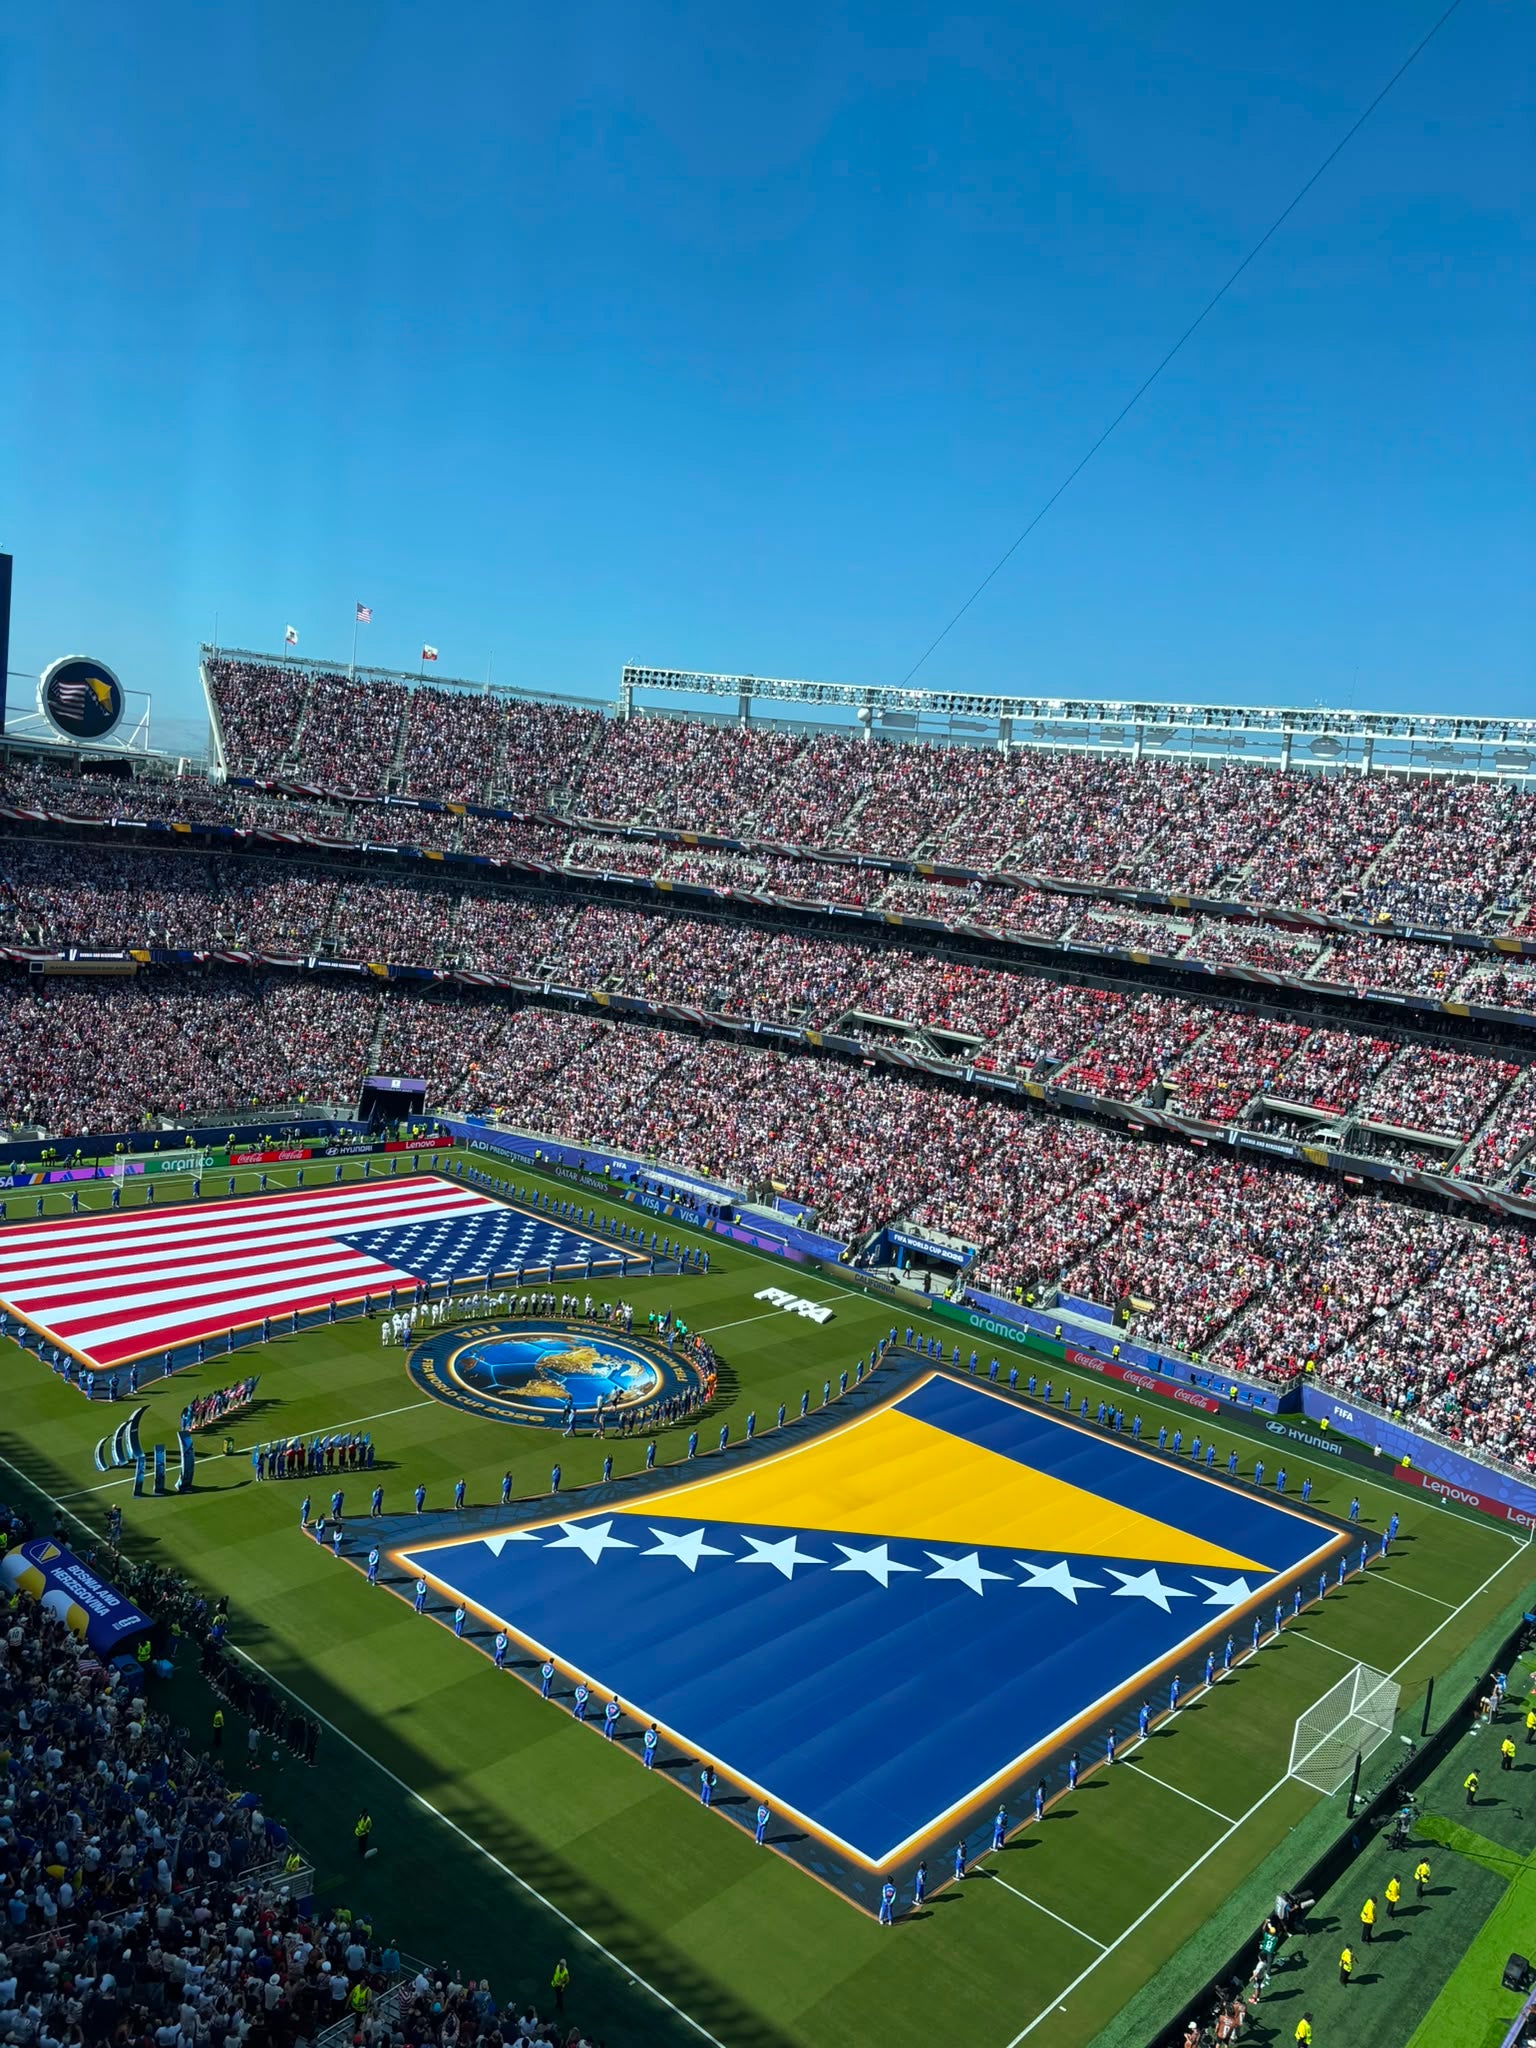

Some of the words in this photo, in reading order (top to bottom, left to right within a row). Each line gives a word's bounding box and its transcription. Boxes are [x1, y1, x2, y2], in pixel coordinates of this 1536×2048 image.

[340, 1145, 372, 1154] HYUNDAI
[405, 1139, 435, 1149] Lenovo
[470, 1139, 489, 1151] ADI
[161, 1156, 214, 1171] aramco
[612, 1160, 627, 1170] FIFA
[555, 1166, 578, 1182] QATAR
[580, 1175, 608, 1192] AIRWAYS
[641, 1195, 660, 1212] VISA
[680, 1210, 700, 1226] VISA
[893, 1234, 907, 1244] FIFA
[907, 1238, 928, 1251] WORLD
[929, 1244, 942, 1254] CUP
[941, 1248, 964, 1263] 2026
[854, 1273, 896, 1295] CALIFORNIA
[754, 1287, 833, 1324] FIFA
[455, 1325, 501, 1338] FIFA
[970, 1314, 1026, 1343] aramco
[421, 1358, 434, 1374] FIFA
[425, 1372, 458, 1397] WORLD
[455, 1394, 485, 1408] CUP
[484, 1407, 545, 1422] 2026
[1333, 1405, 1354, 1422] FIFA
[1288, 1428, 1342, 1455] HYUNDAI
[1422, 1475, 1480, 1506] Lenovo
[50, 1567, 111, 1617] HERZEGOVINA
[67, 1564, 102, 1592] BOSNIA
[96, 1590, 120, 1607] AND
